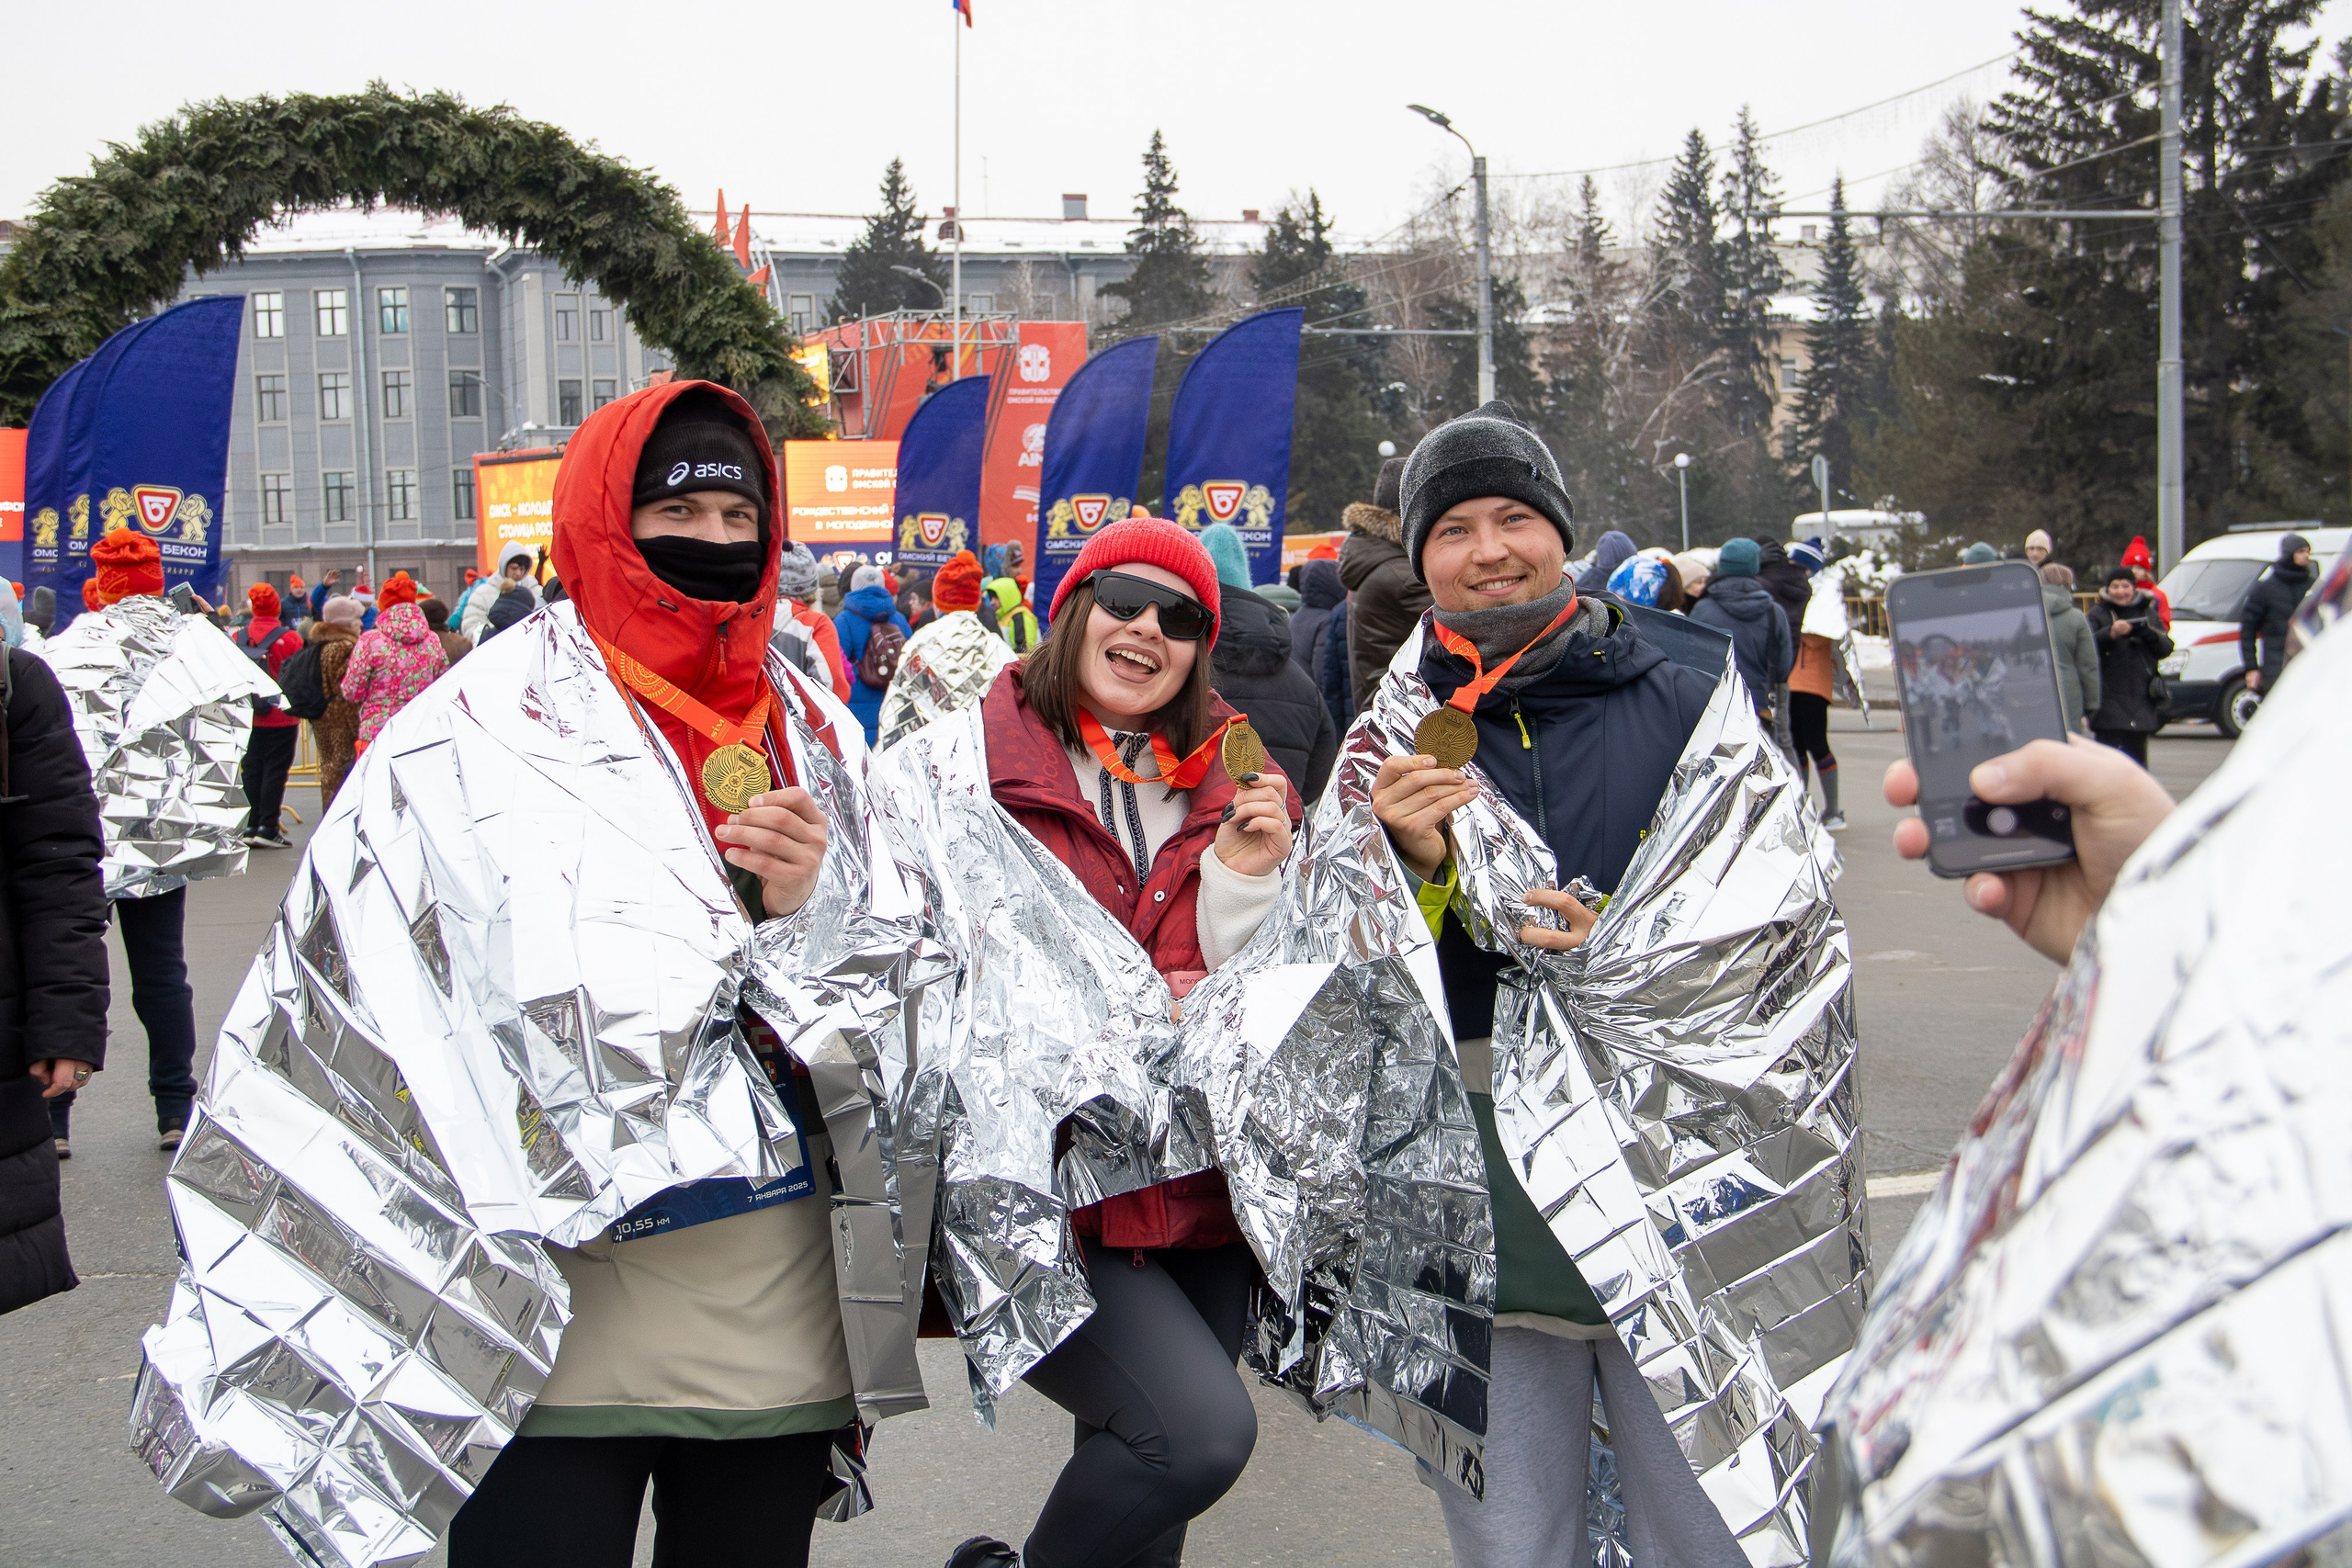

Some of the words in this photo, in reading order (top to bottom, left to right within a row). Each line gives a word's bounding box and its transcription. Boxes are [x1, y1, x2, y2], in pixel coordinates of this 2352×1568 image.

[695, 462, 741, 480] asics
[163, 544, 208, 558] БЕКОН
[747, 1195, 753, 1203] 7
[787, 1180, 808, 1194] 2025
[616, 1217, 654, 1235] 10,55
